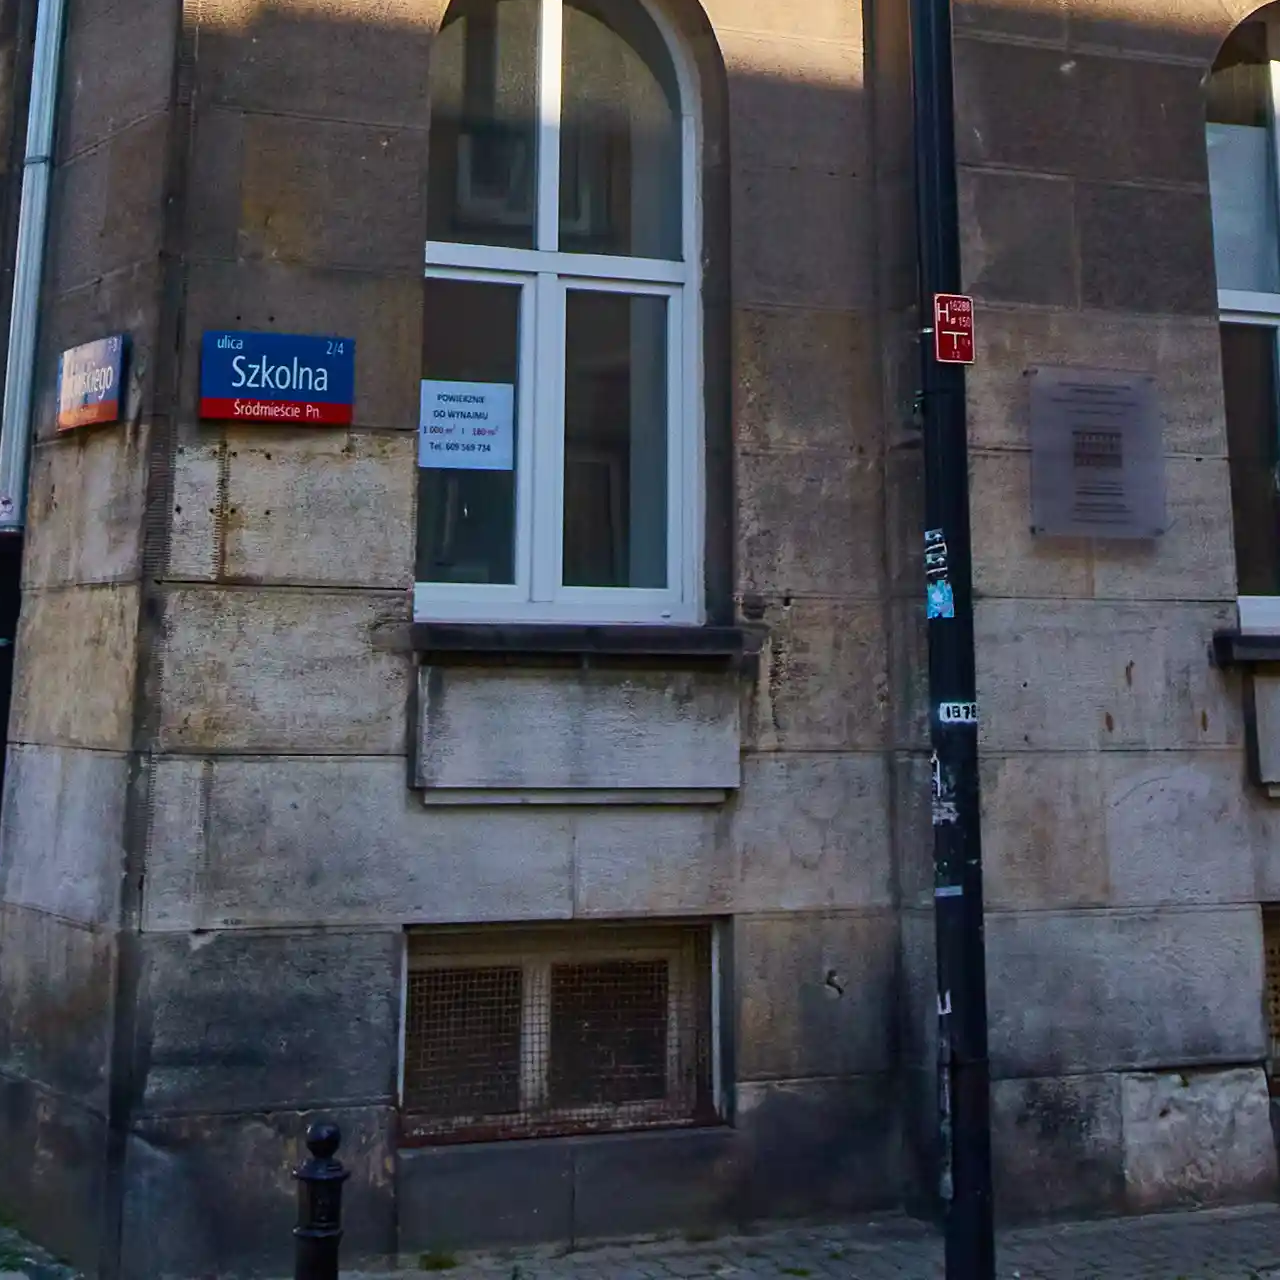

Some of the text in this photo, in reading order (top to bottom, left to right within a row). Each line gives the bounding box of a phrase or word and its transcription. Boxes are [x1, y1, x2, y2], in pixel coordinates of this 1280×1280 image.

[937, 302, 949, 322] H
[217, 335, 345, 356] ulica 2/4
[231, 355, 328, 392] Szkolna
[233, 398, 301, 419] Śródmieście
[433, 409, 446, 418] DO
